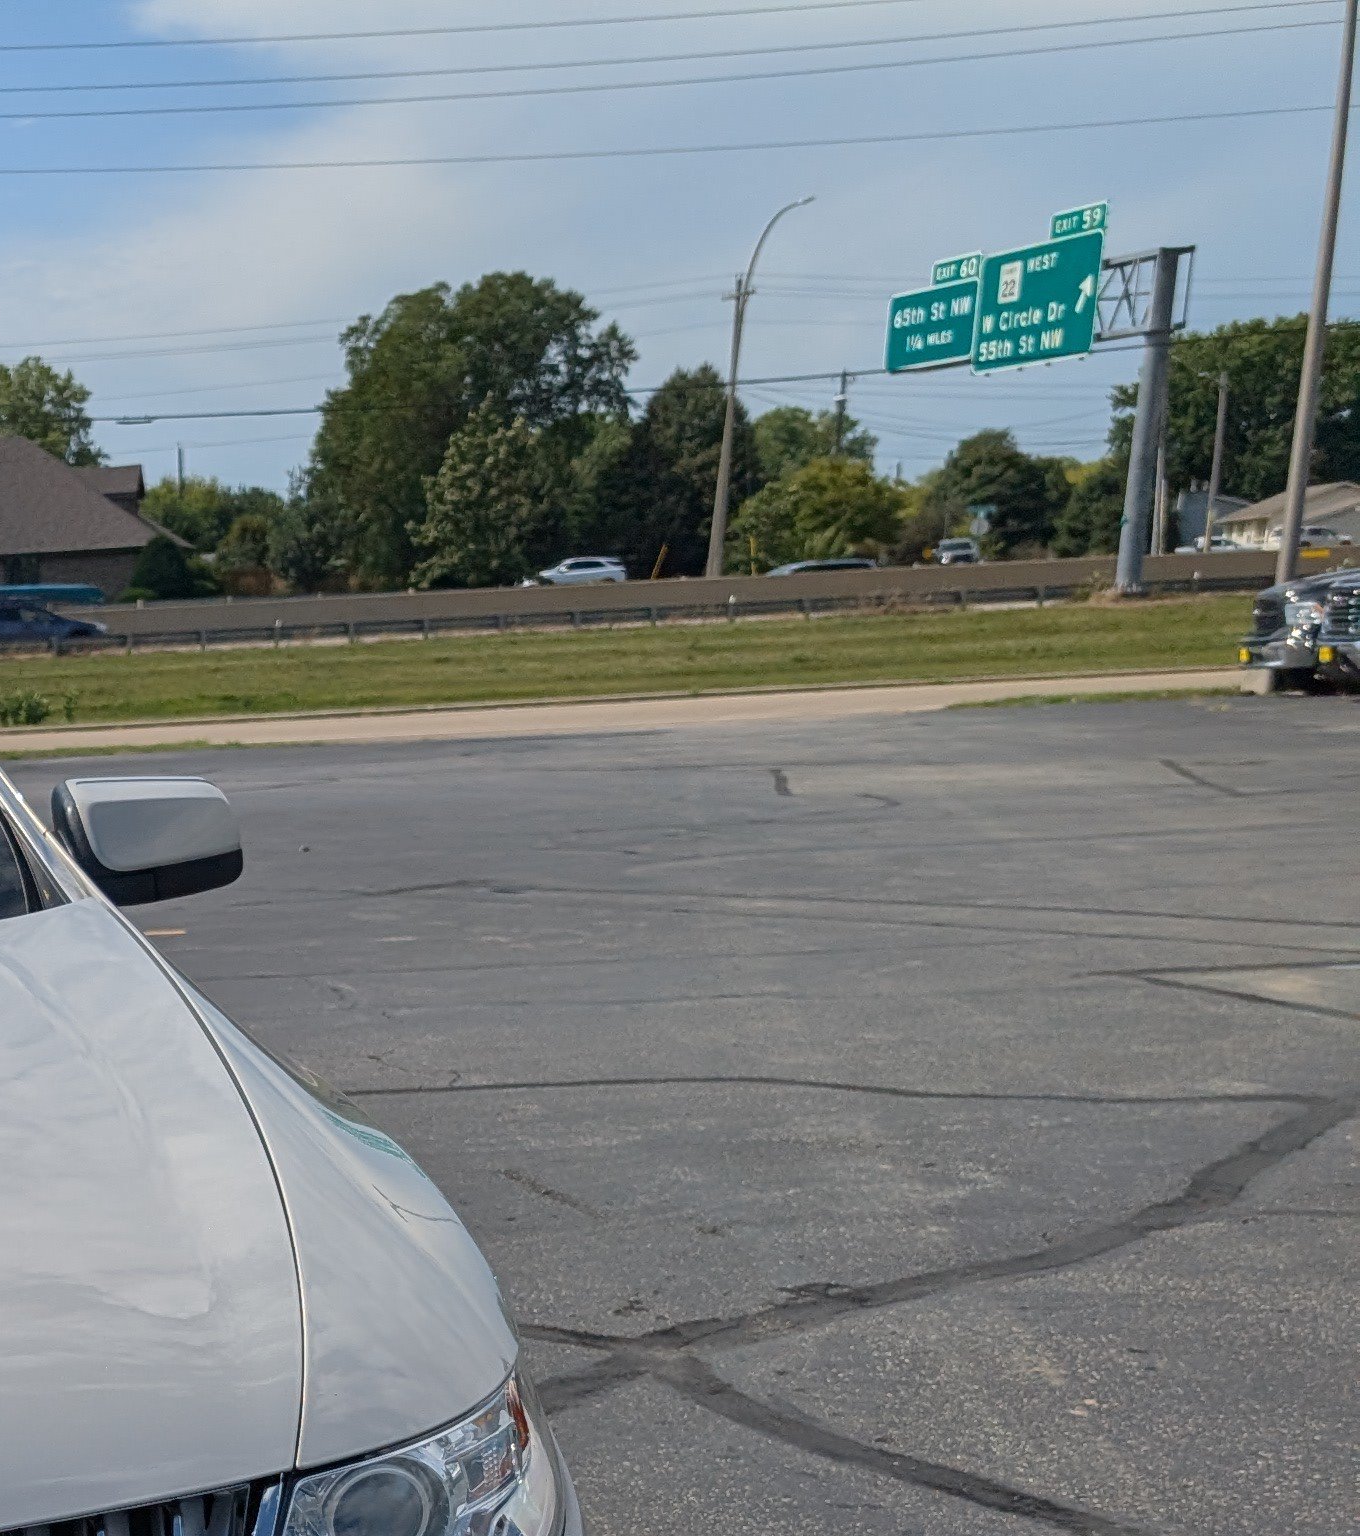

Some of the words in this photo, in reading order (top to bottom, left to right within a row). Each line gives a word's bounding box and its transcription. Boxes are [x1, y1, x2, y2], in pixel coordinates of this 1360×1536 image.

[1081, 208, 1102, 230] 59
[960, 258, 977, 277] 60
[1027, 252, 1059, 273] WEST
[1001, 279, 1016, 298] 22
[894, 306, 925, 329] 65th
[931, 301, 946, 321] St
[950, 295, 972, 317] NW
[982, 314, 995, 334] W
[999, 306, 1042, 331] Circle
[1047, 301, 1066, 322] Dr
[927, 330, 953, 346] MILES
[979, 339, 1012, 362] 55th
[1019, 334, 1034, 354] St
[1040, 327, 1063, 350] NW
